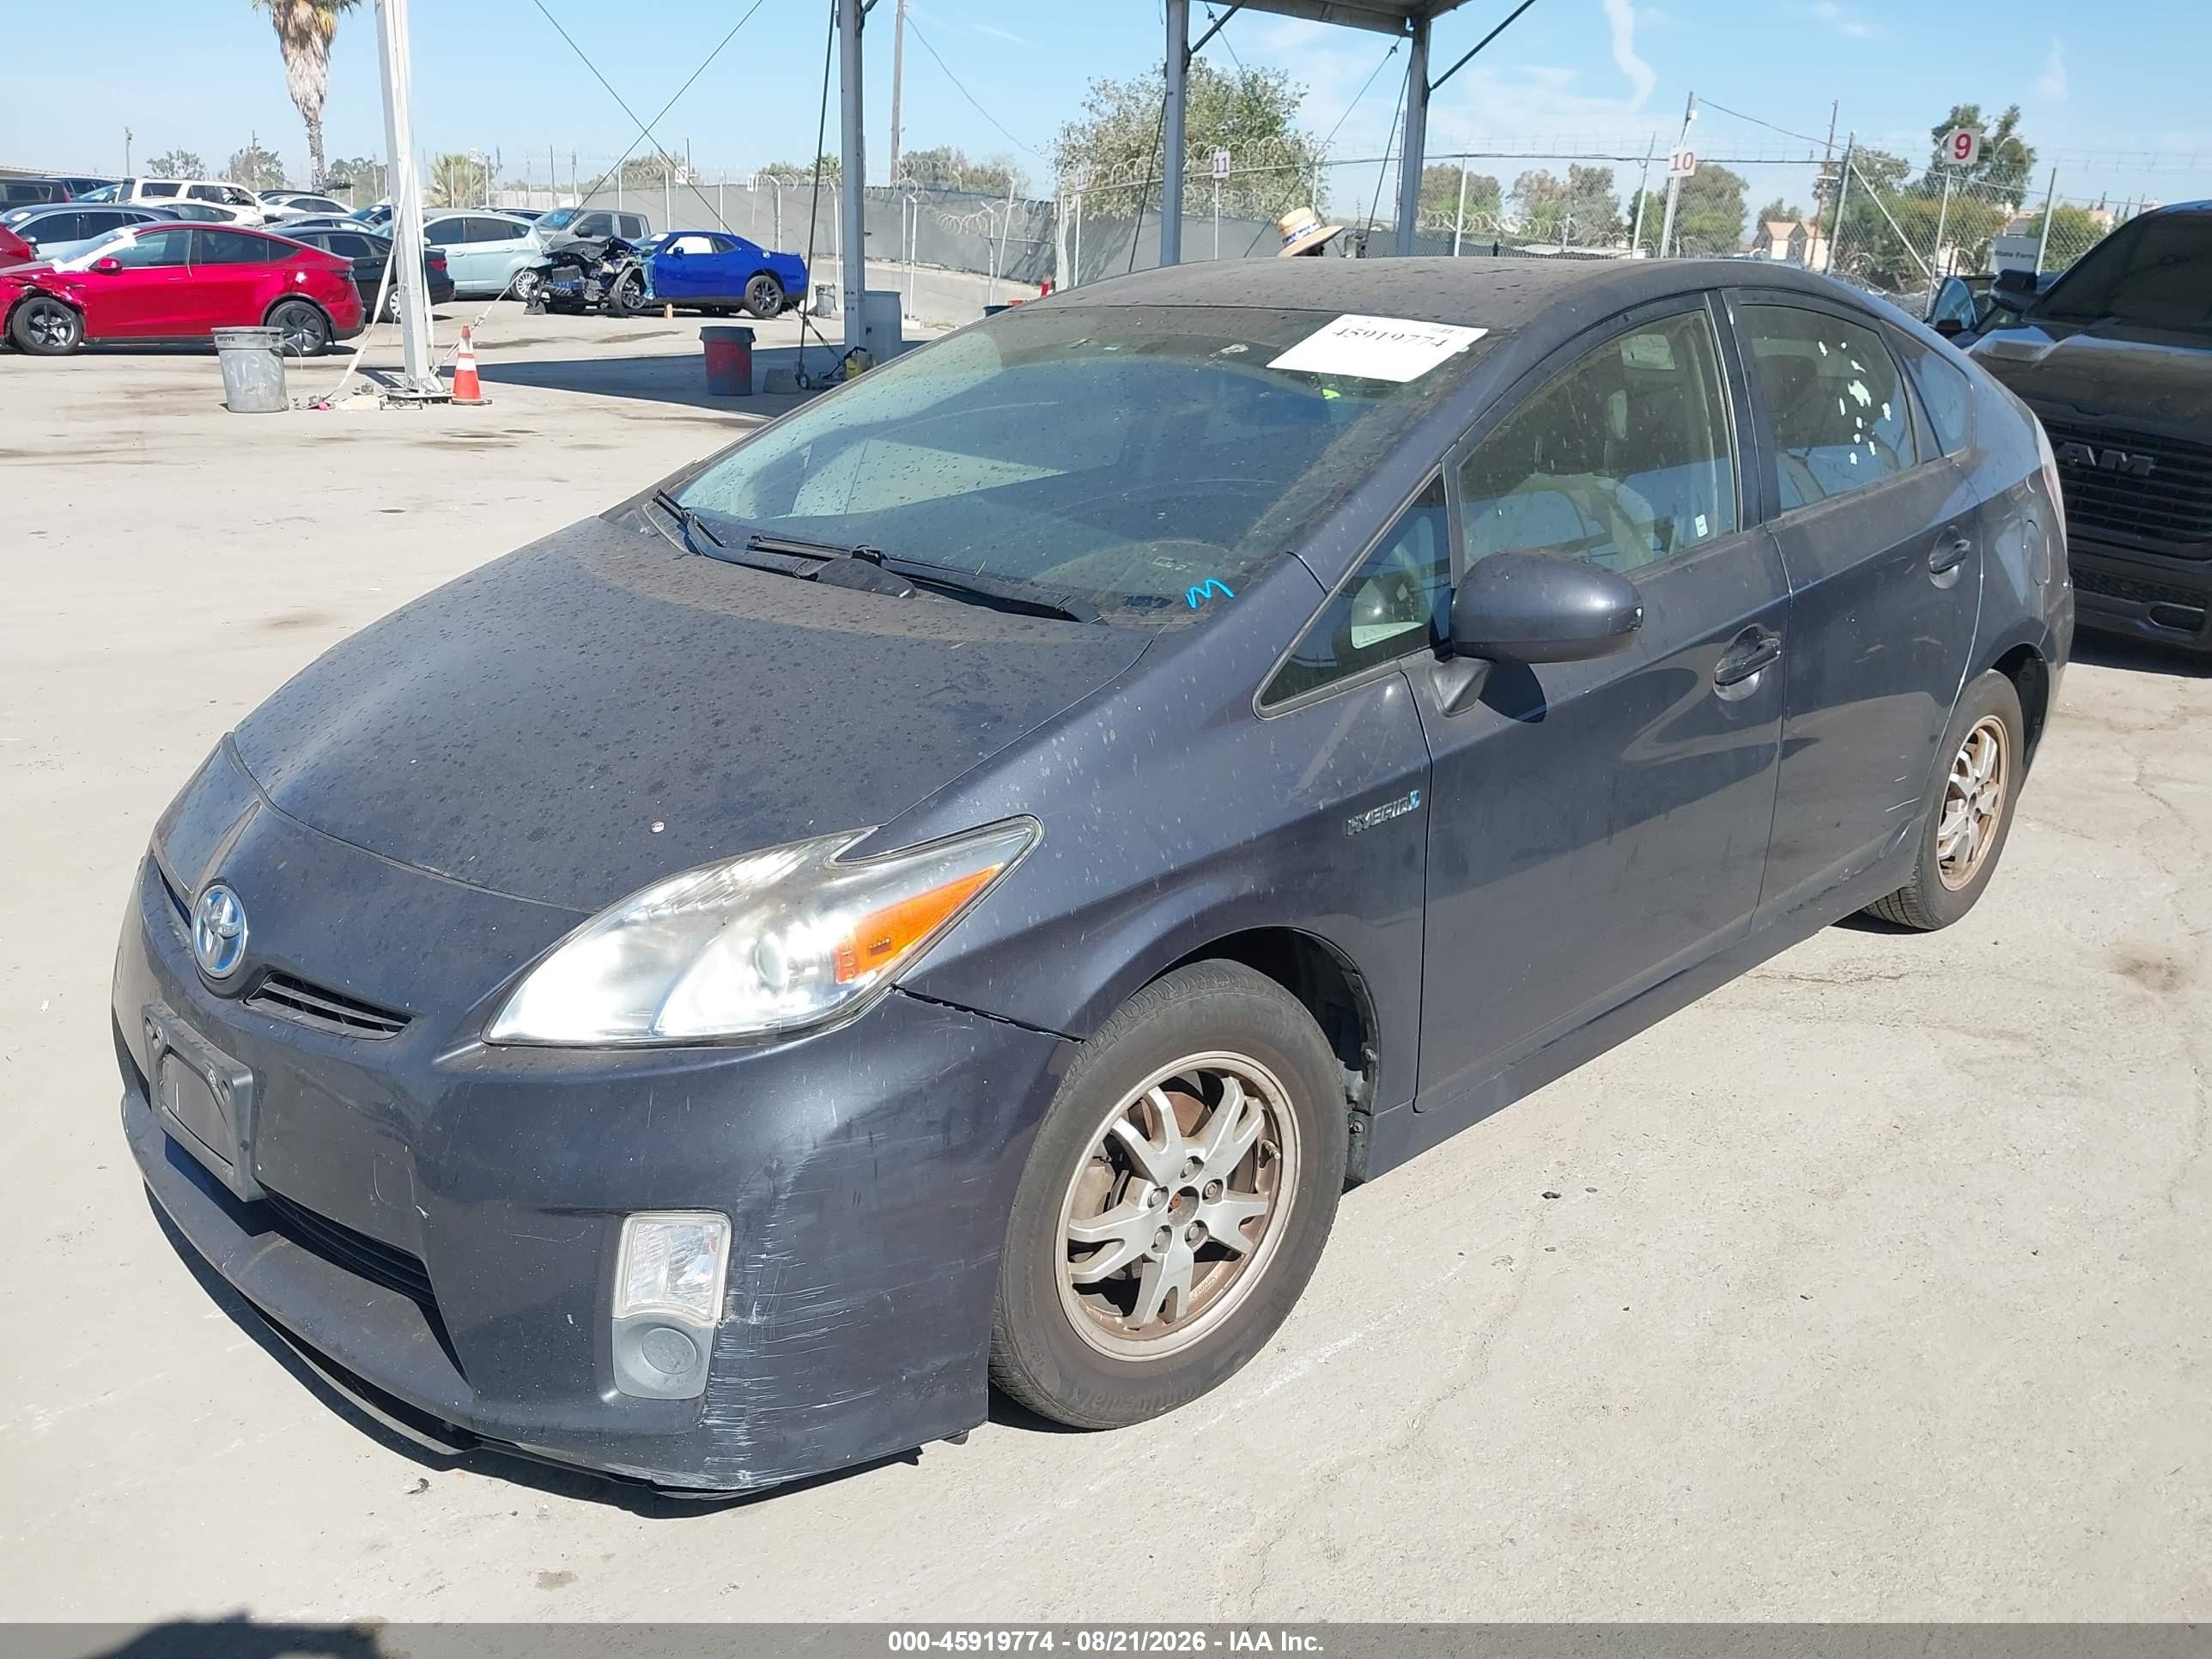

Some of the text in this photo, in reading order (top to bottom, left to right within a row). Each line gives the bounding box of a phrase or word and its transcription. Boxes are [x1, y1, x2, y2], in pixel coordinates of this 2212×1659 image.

[1954, 133, 1972, 161] 9
[1214, 156, 1228, 173] 11
[1670, 152, 1694, 171] 10
